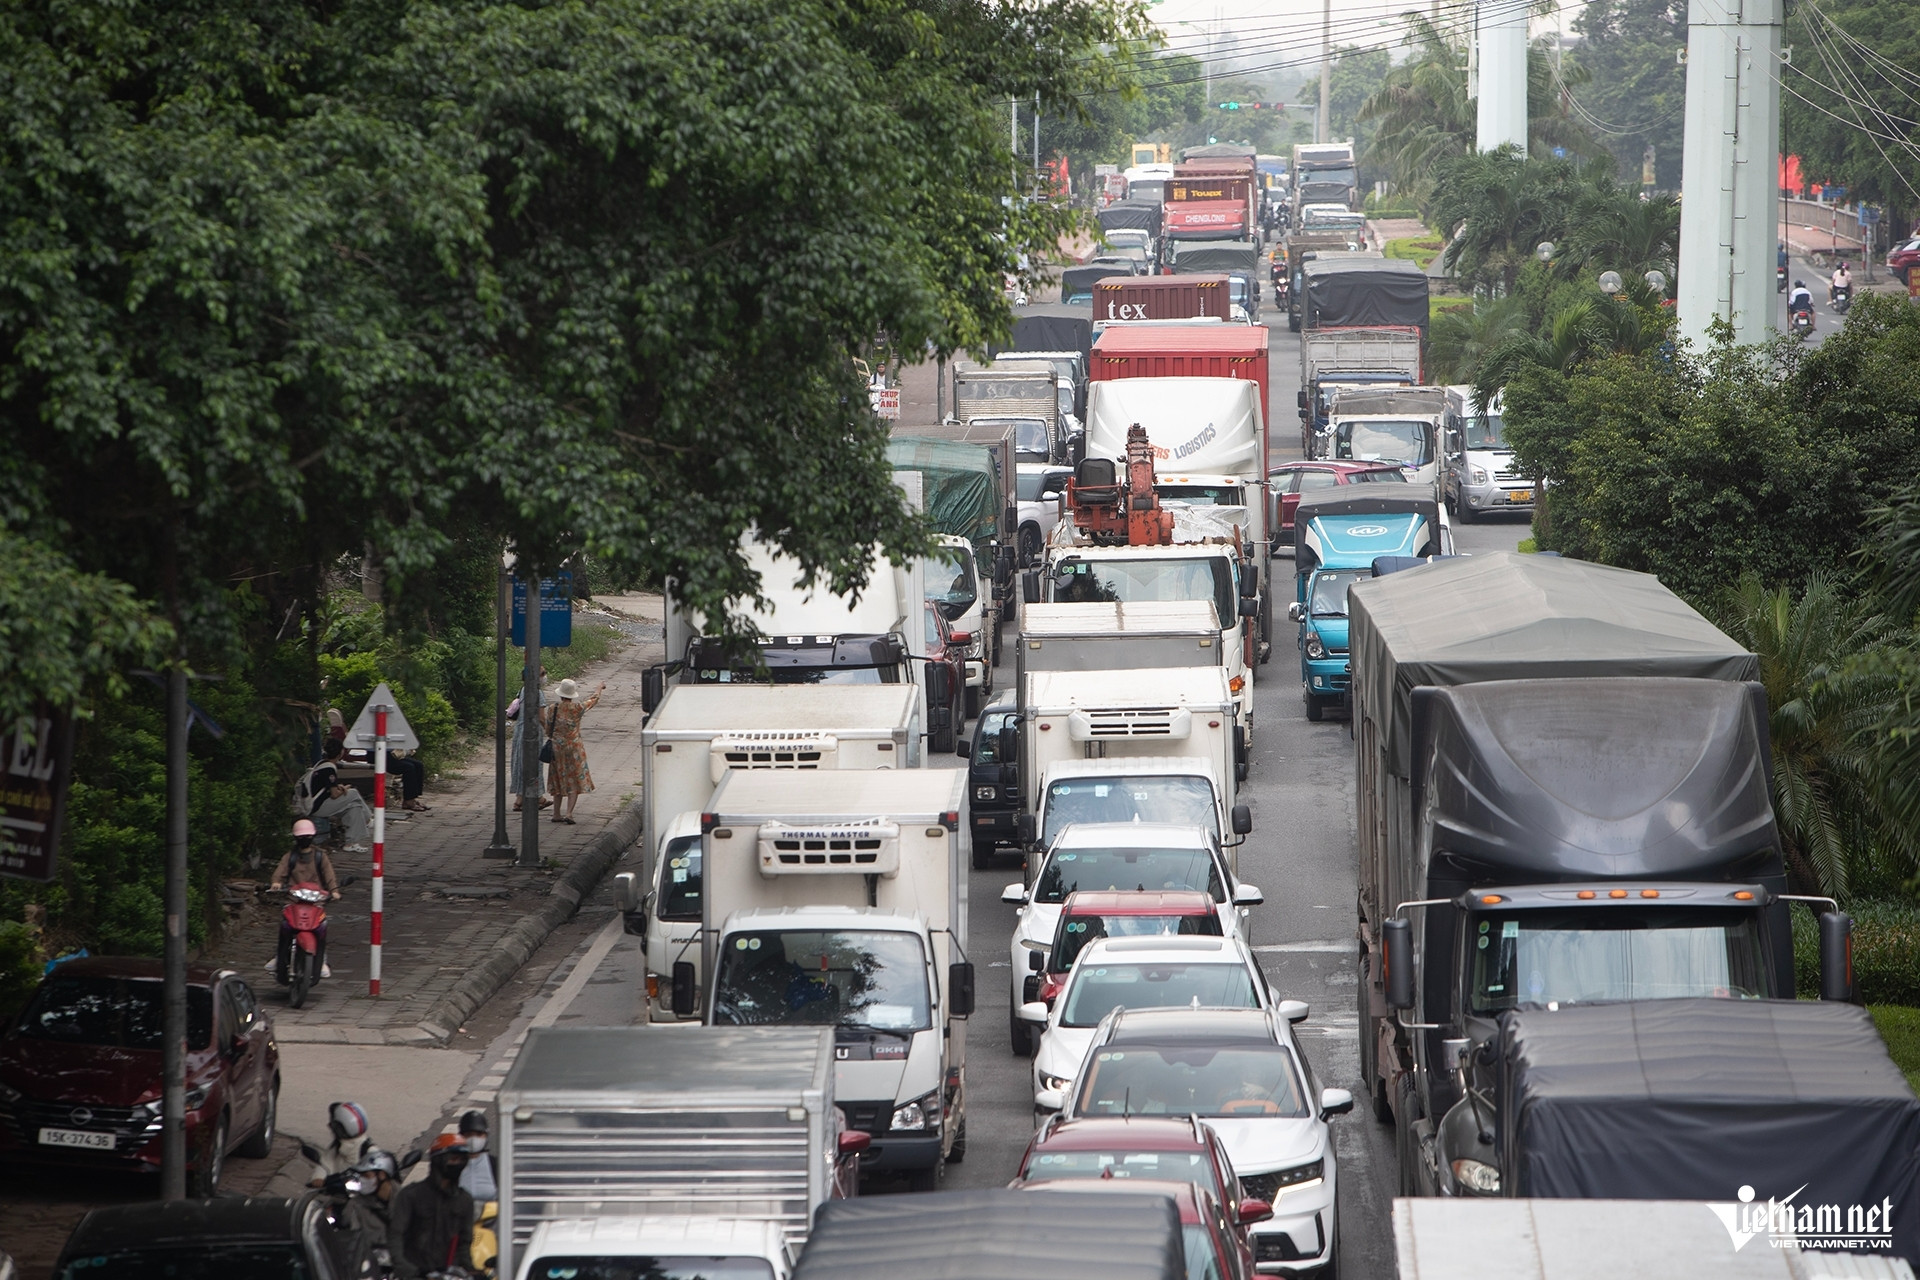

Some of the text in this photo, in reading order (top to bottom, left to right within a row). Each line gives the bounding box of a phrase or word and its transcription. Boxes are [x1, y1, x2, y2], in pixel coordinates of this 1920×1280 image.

[1185, 214, 1226, 223] CHENGLONG
[1107, 300, 1147, 320] tex
[1173, 422, 1217, 460] LOGISTICS
[781, 831, 870, 839] THERMAL MASTER
[46, 1131, 109, 1148] 15K-374.36
